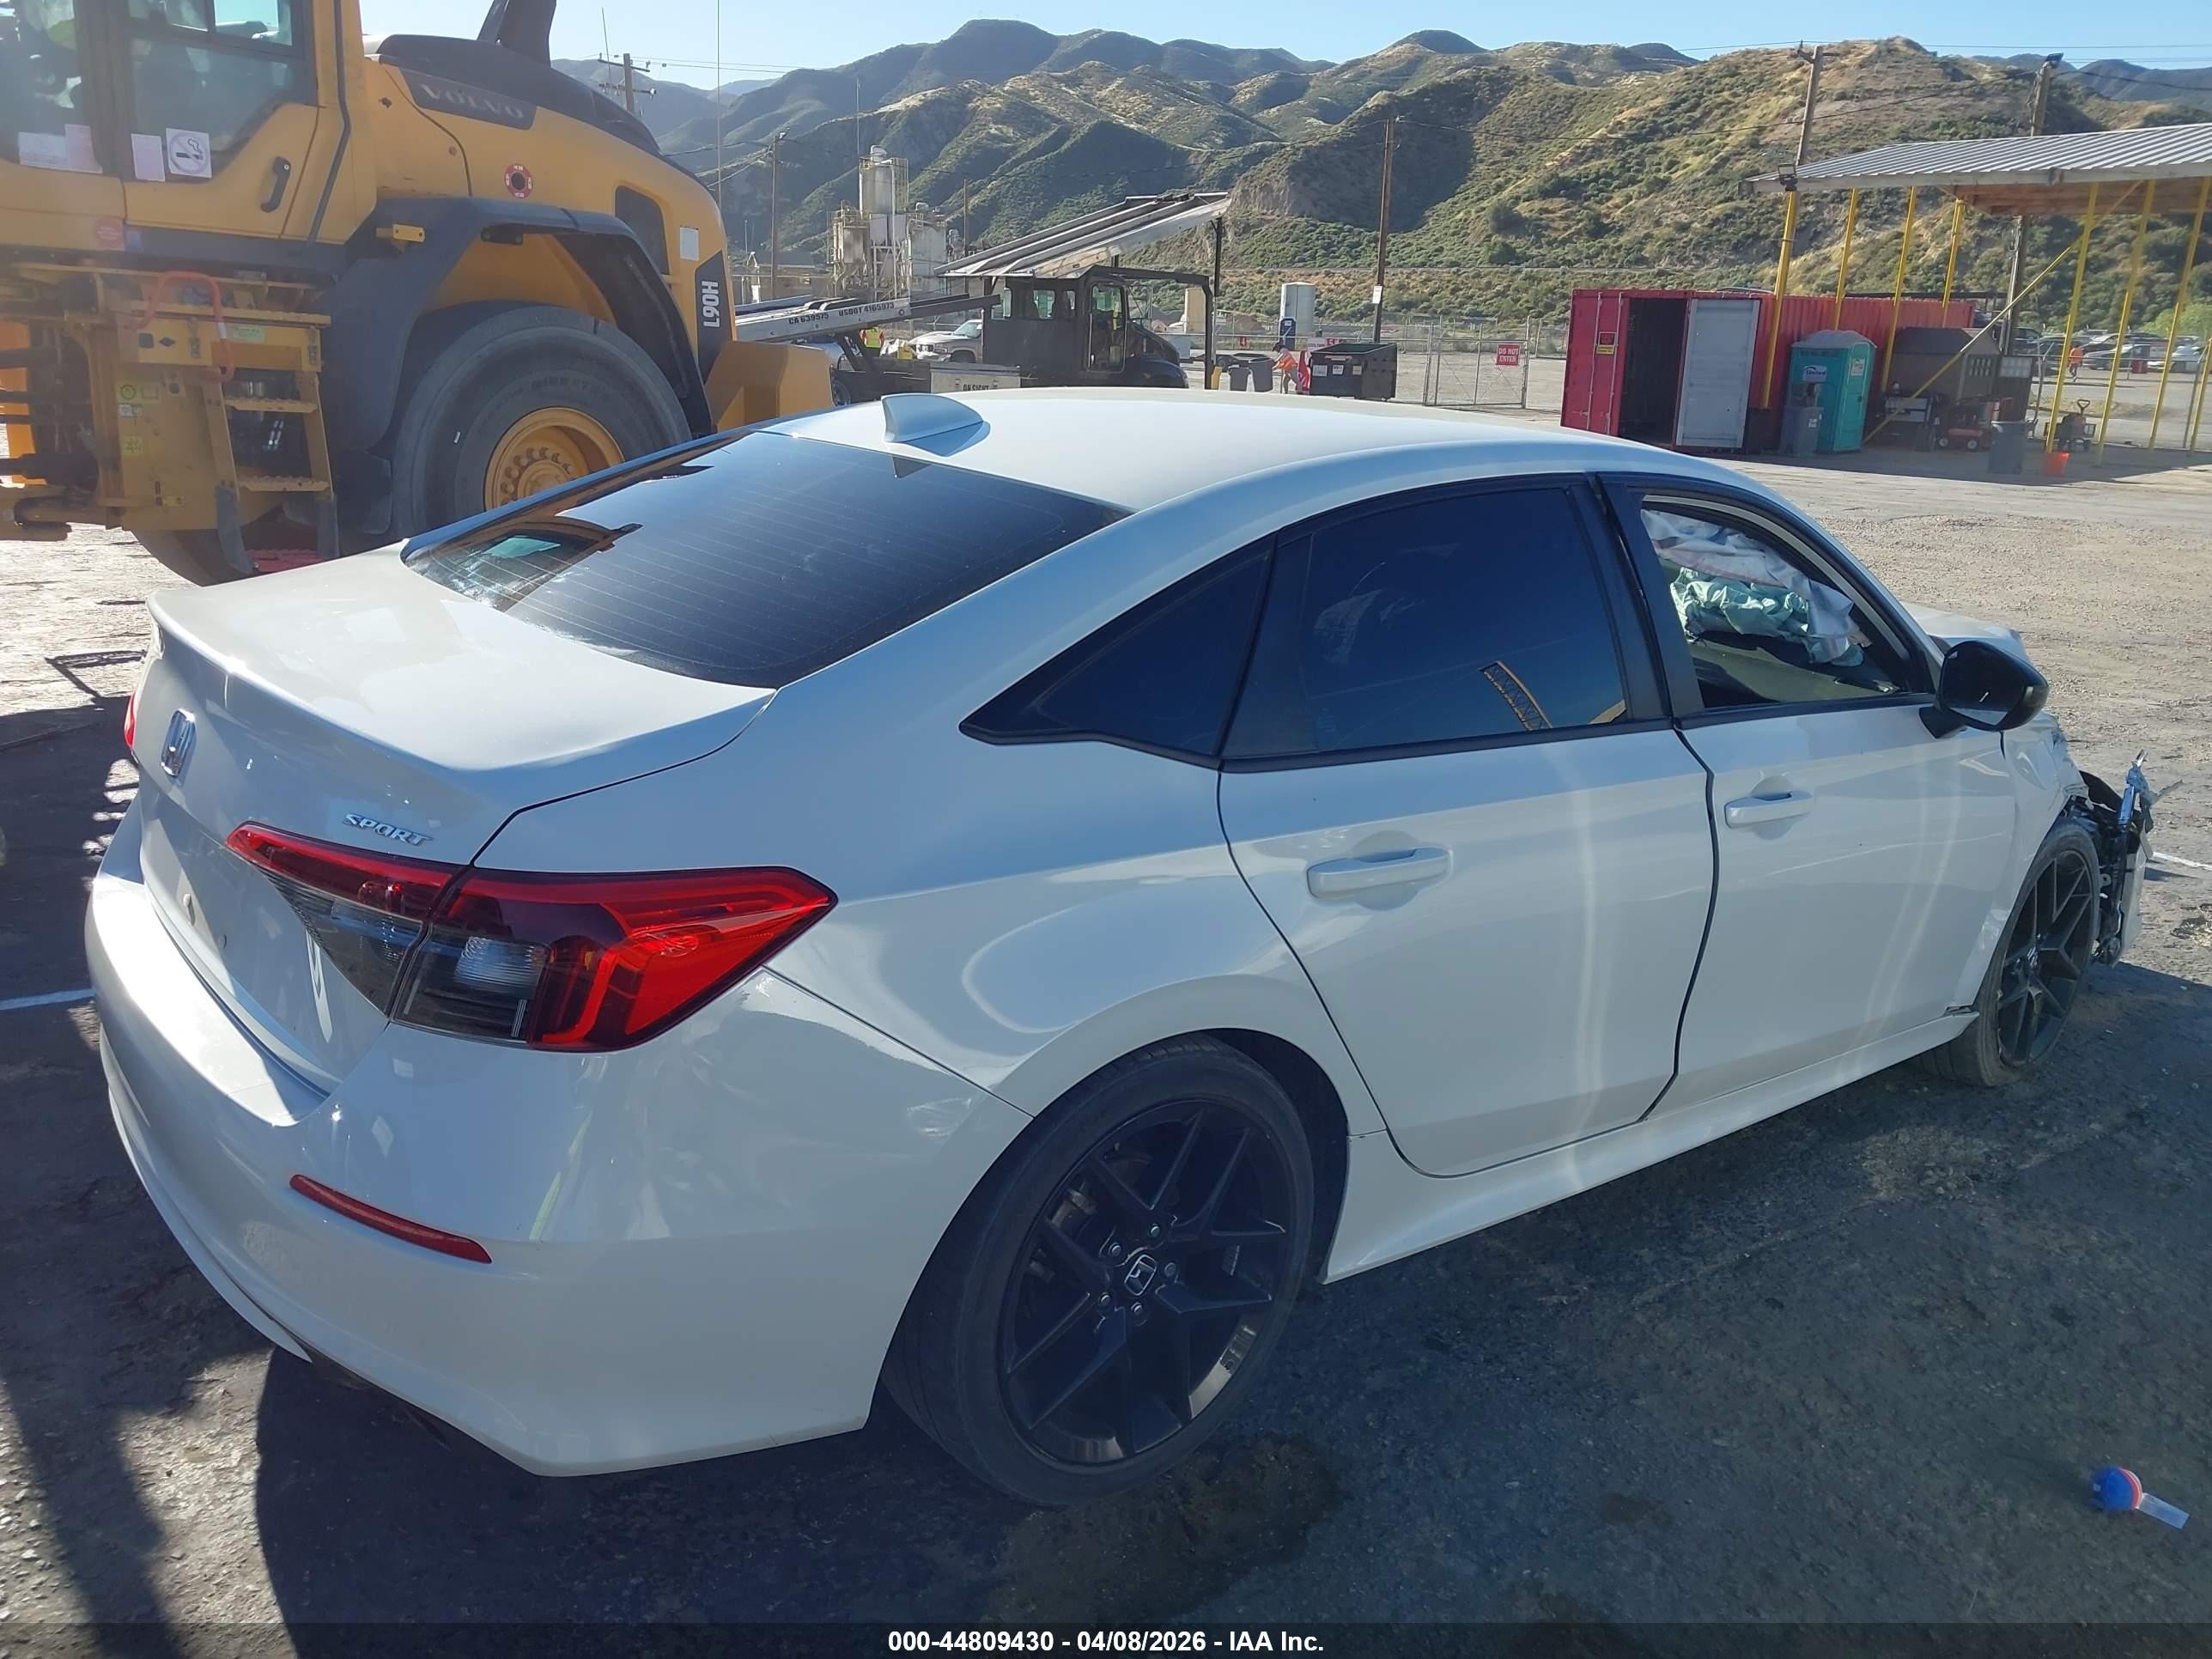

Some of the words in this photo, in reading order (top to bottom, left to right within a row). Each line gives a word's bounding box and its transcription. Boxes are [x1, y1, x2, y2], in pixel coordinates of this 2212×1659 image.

[421, 84, 525, 118] VOLVO
[701, 280, 720, 327] L90H
[838, 307, 862, 317] USDOT
[343, 812, 433, 846] SPORT
